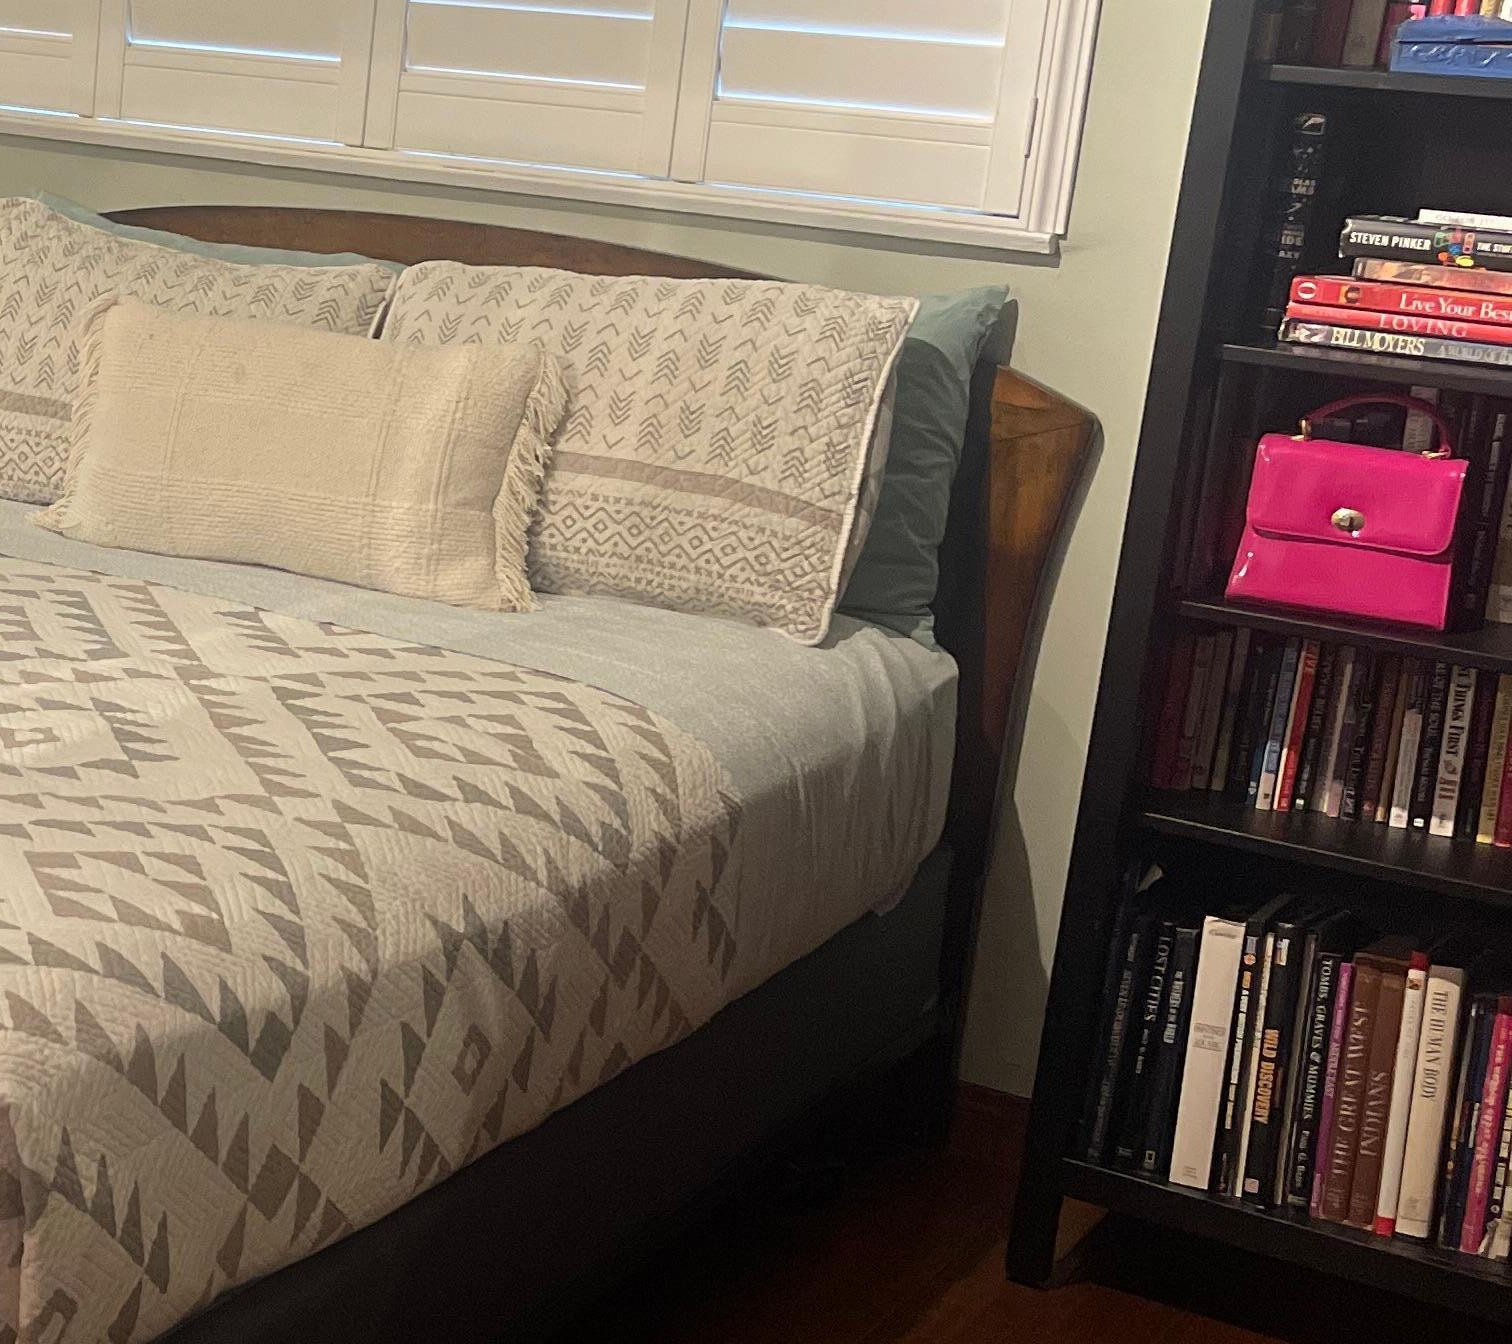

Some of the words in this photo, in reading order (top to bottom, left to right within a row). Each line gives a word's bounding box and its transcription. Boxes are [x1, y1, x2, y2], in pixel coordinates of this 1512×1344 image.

[1350, 232, 1390, 247] STEVEN
[1391, 235, 1432, 251] PINKER
[1399, 293, 1436, 313] Live
[1437, 296, 1476, 317] Your
[1330, 327, 1362, 347] BILL
[1361, 330, 1426, 356] MOYERS
[1379, 314, 1468, 338] LOVING
[1451, 683, 1473, 722] THINGS
[1445, 725, 1465, 757] FIRST
[1153, 936, 1171, 974] LOST
[1143, 975, 1163, 1022] CITIES
[1431, 991, 1448, 1015] THE
[1262, 1028, 1280, 1058] WILD
[1311, 1005, 1327, 1050] GRAVES
[1426, 1018, 1445, 1063] HUMAN
[1254, 1060, 1276, 1124] DISCOVERY
[1303, 1064, 1320, 1120] MUMMIES
[1421, 1067, 1440, 1099] BODY
[1359, 1071, 1389, 1156] INDIANS
